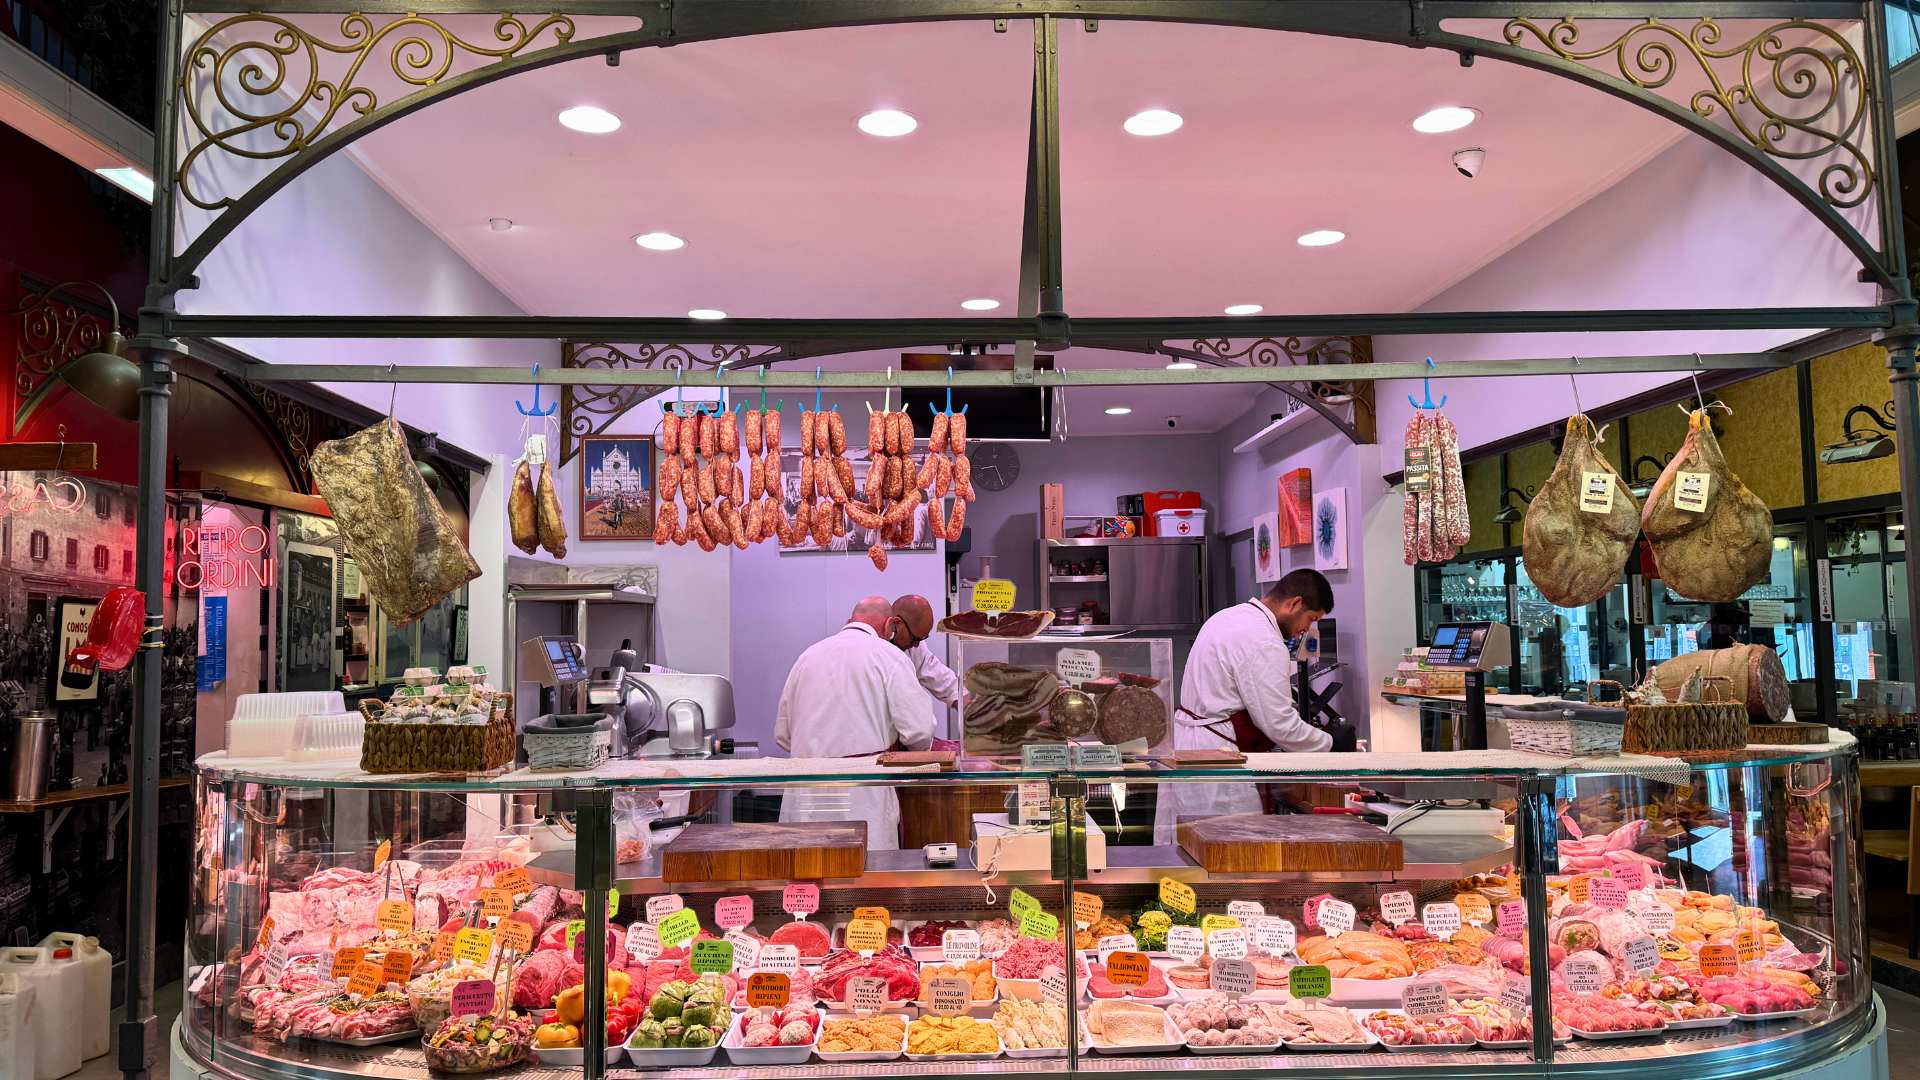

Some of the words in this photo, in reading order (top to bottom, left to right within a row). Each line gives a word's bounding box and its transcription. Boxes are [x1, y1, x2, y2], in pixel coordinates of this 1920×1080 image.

[1406, 464, 1429, 472] PASSITA
[182, 526, 267, 556] RITIRO
[177, 558, 274, 589] ORDINI
[67, 622, 89, 633] CONOS
[1060, 663, 1095, 672] TOSCANO
[1063, 659, 1094, 668] SALAME
[666, 919, 688, 933] GIRELLO
[1634, 957, 1653, 965] POLLO
[1108, 962, 1148, 972] VALDOSTANA
[1408, 995, 1441, 1004] INVOLTINO
[1426, 999, 1446, 1008] DOLCE
